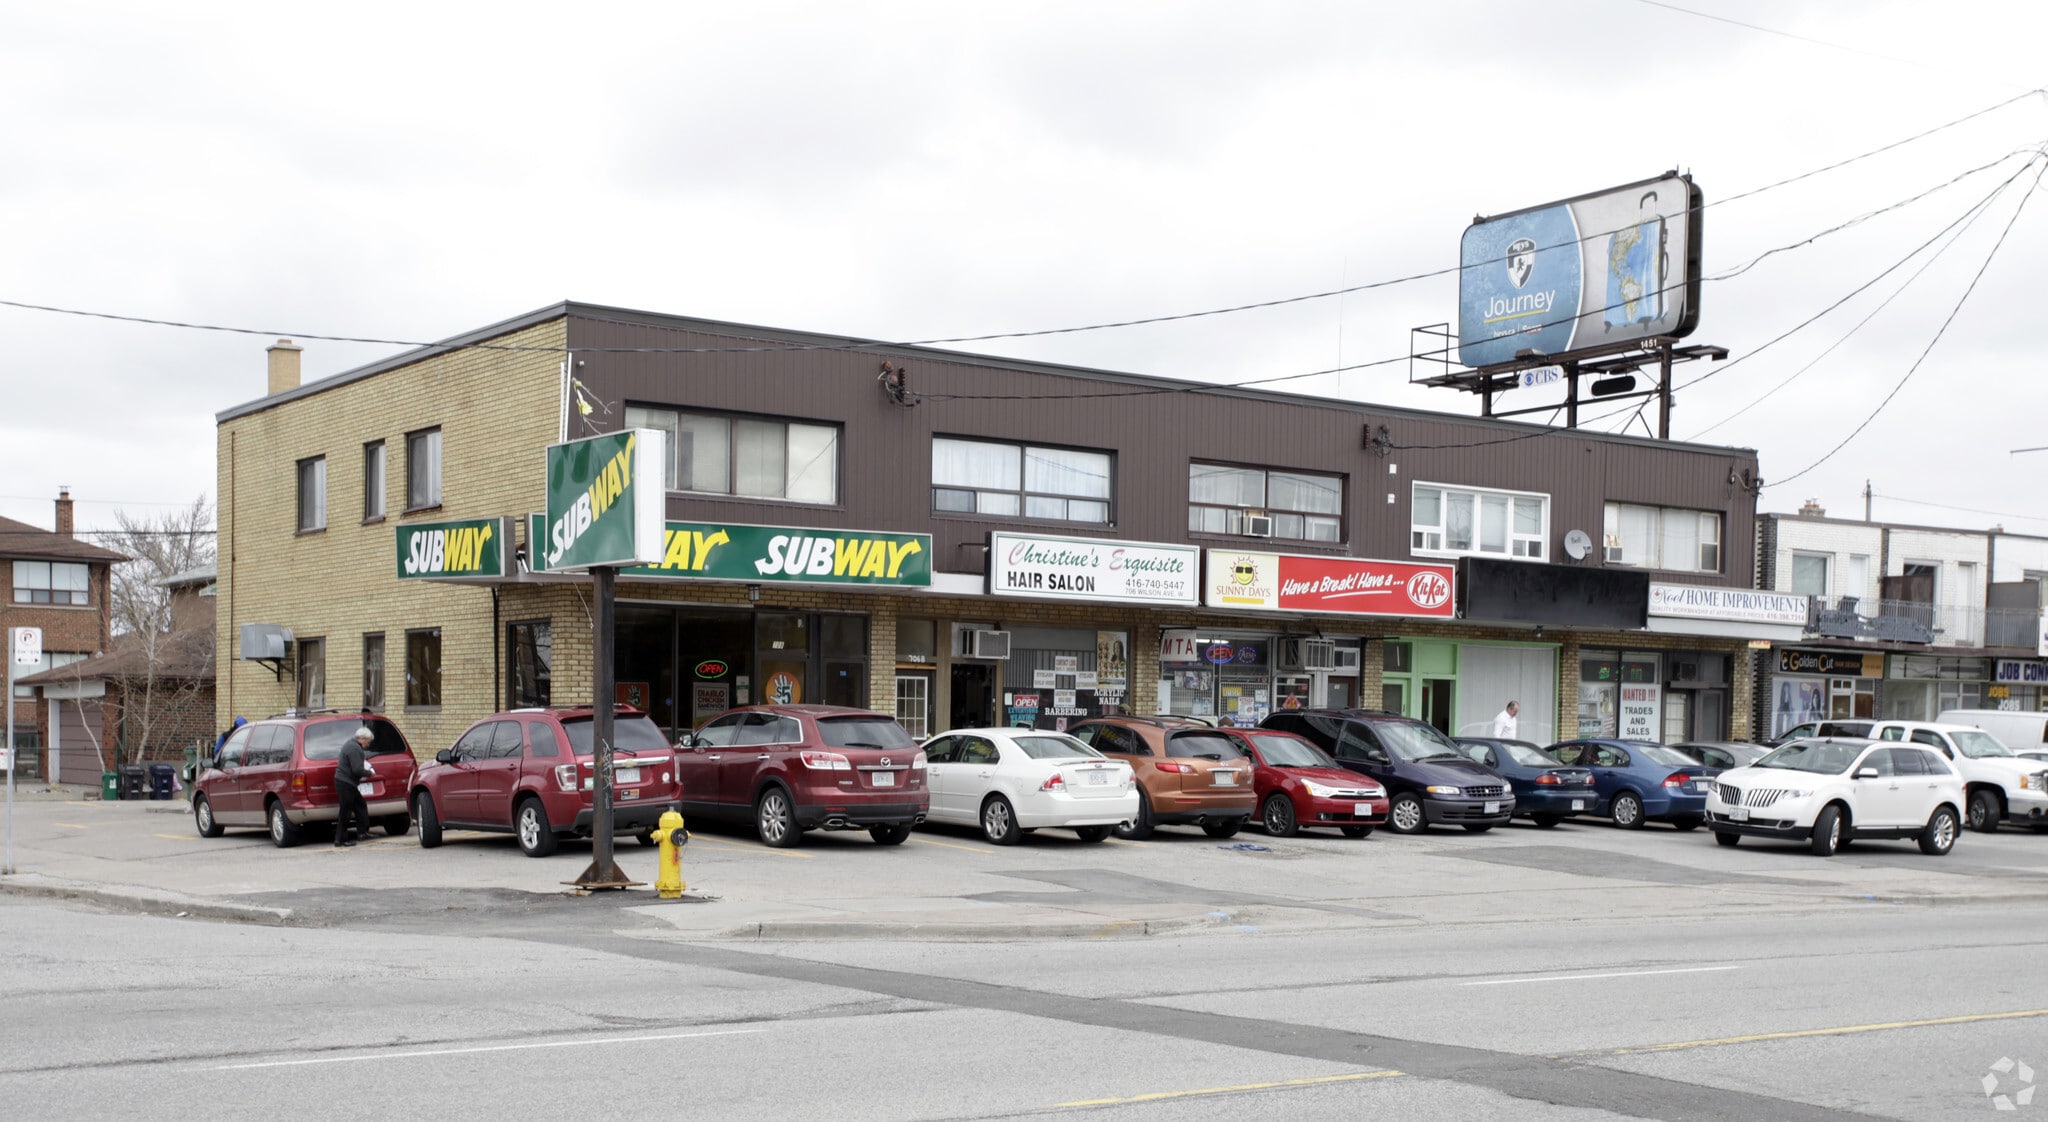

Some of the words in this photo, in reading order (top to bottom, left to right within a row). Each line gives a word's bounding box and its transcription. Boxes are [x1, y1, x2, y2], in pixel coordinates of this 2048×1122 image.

[1484, 289, 1555, 318] Journey
[1640, 338, 1657, 348] 1451
[1535, 371, 1558, 385] CBS
[548, 433, 636, 566] SUBWAY
[404, 522, 492, 575] SUBWAY
[755, 535, 921, 578] SUBWAY
[1008, 541, 1100, 567] Christine's
[1109, 548, 1184, 577] Exquisite
[1007, 571, 1043, 589] HAIR
[1048, 573, 1095, 592] SALON
[1125, 579, 1185, 590] 416-740-5447
[1281, 579, 1309, 597] Have
[1310, 583, 1317, 593] a
[1319, 574, 1357, 593] Break!
[1357, 571, 1384, 588] Have
[1138, 589, 1162, 597] WILSON
[1216, 586, 1246, 596] SUNNY
[1249, 587, 1271, 598] DAYS
[1686, 589, 1719, 607] HOME
[1723, 592, 1805, 612] IMPROVEMENTS
[1208, 647, 1234, 659] OPEN
[1789, 652, 1818, 671] Golden
[1818, 654, 1834, 672] Cut
[699, 664, 724, 674] OPEN
[1999, 662, 2020, 680] JOB
[1094, 689, 1124, 697] ACRYLIC
[1622, 688, 1646, 702] WANTED
[1988, 686, 2010, 698] JOBS
[1015, 699, 1037, 707] OPEN
[1099, 697, 1120, 705] NAILS
[1998, 699, 2020, 711] JOBS
[1045, 708, 1087, 716] BARBERING
[1624, 707, 1653, 715] TRADES
[1630, 717, 1646, 725] AND
[1626, 727, 1650, 735] SALES
